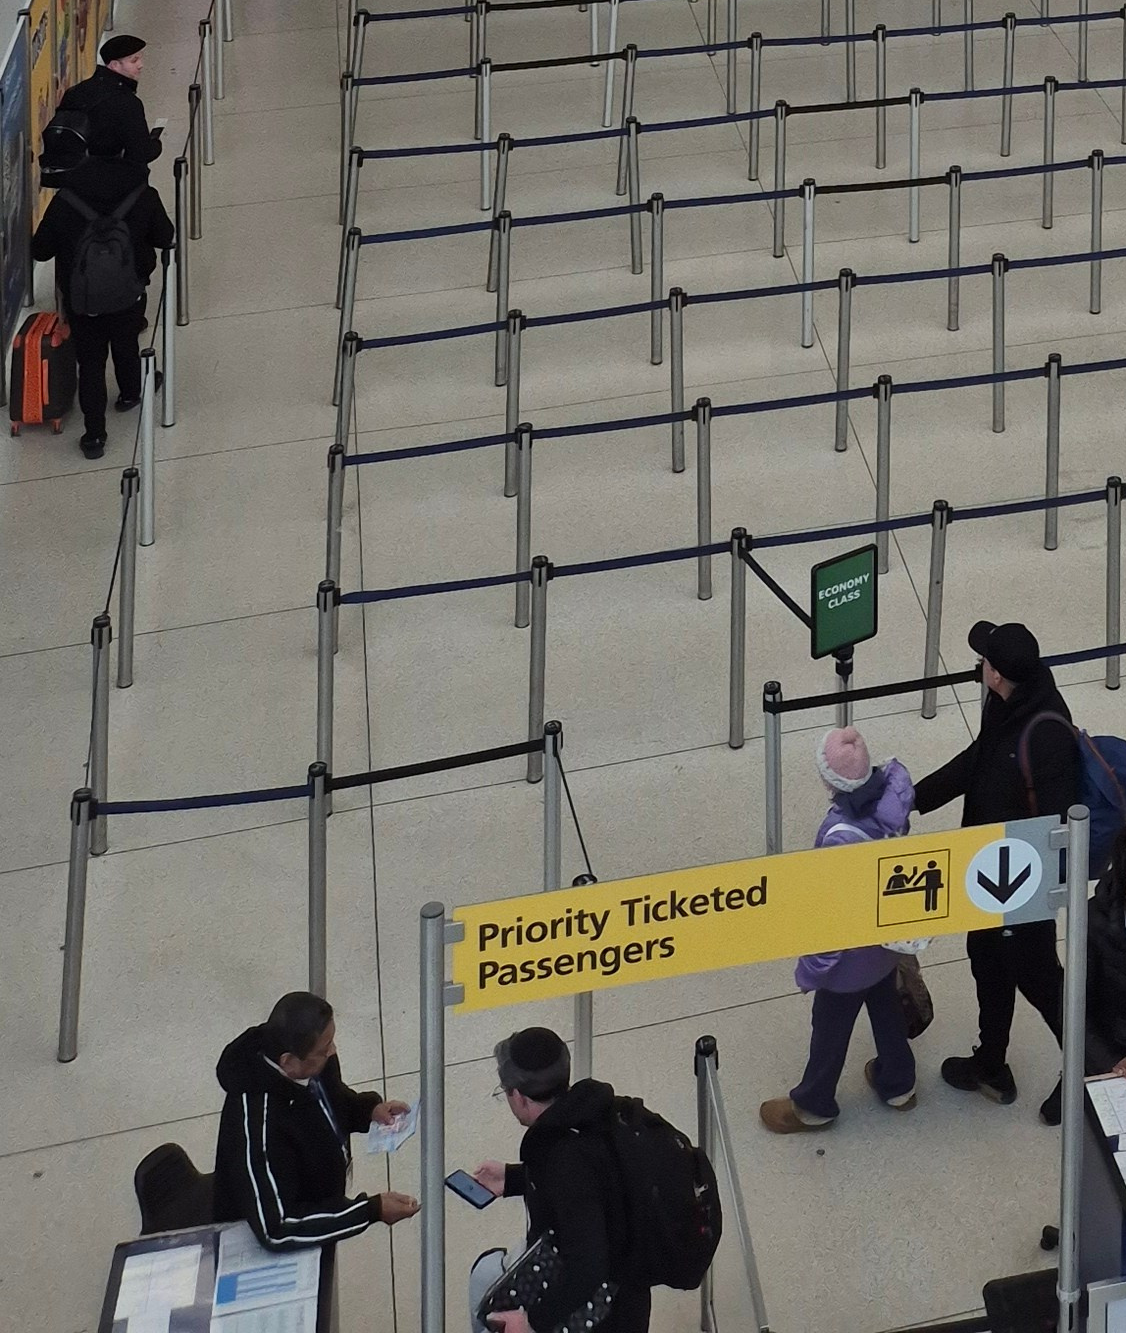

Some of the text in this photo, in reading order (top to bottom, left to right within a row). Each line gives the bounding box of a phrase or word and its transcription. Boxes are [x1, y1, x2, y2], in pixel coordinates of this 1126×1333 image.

[818, 573, 870, 600] ECONOMY
[828, 589, 861, 609] CLASS
[478, 875, 768, 952] Priority Ticketed
[478, 935, 675, 990] Passengers
